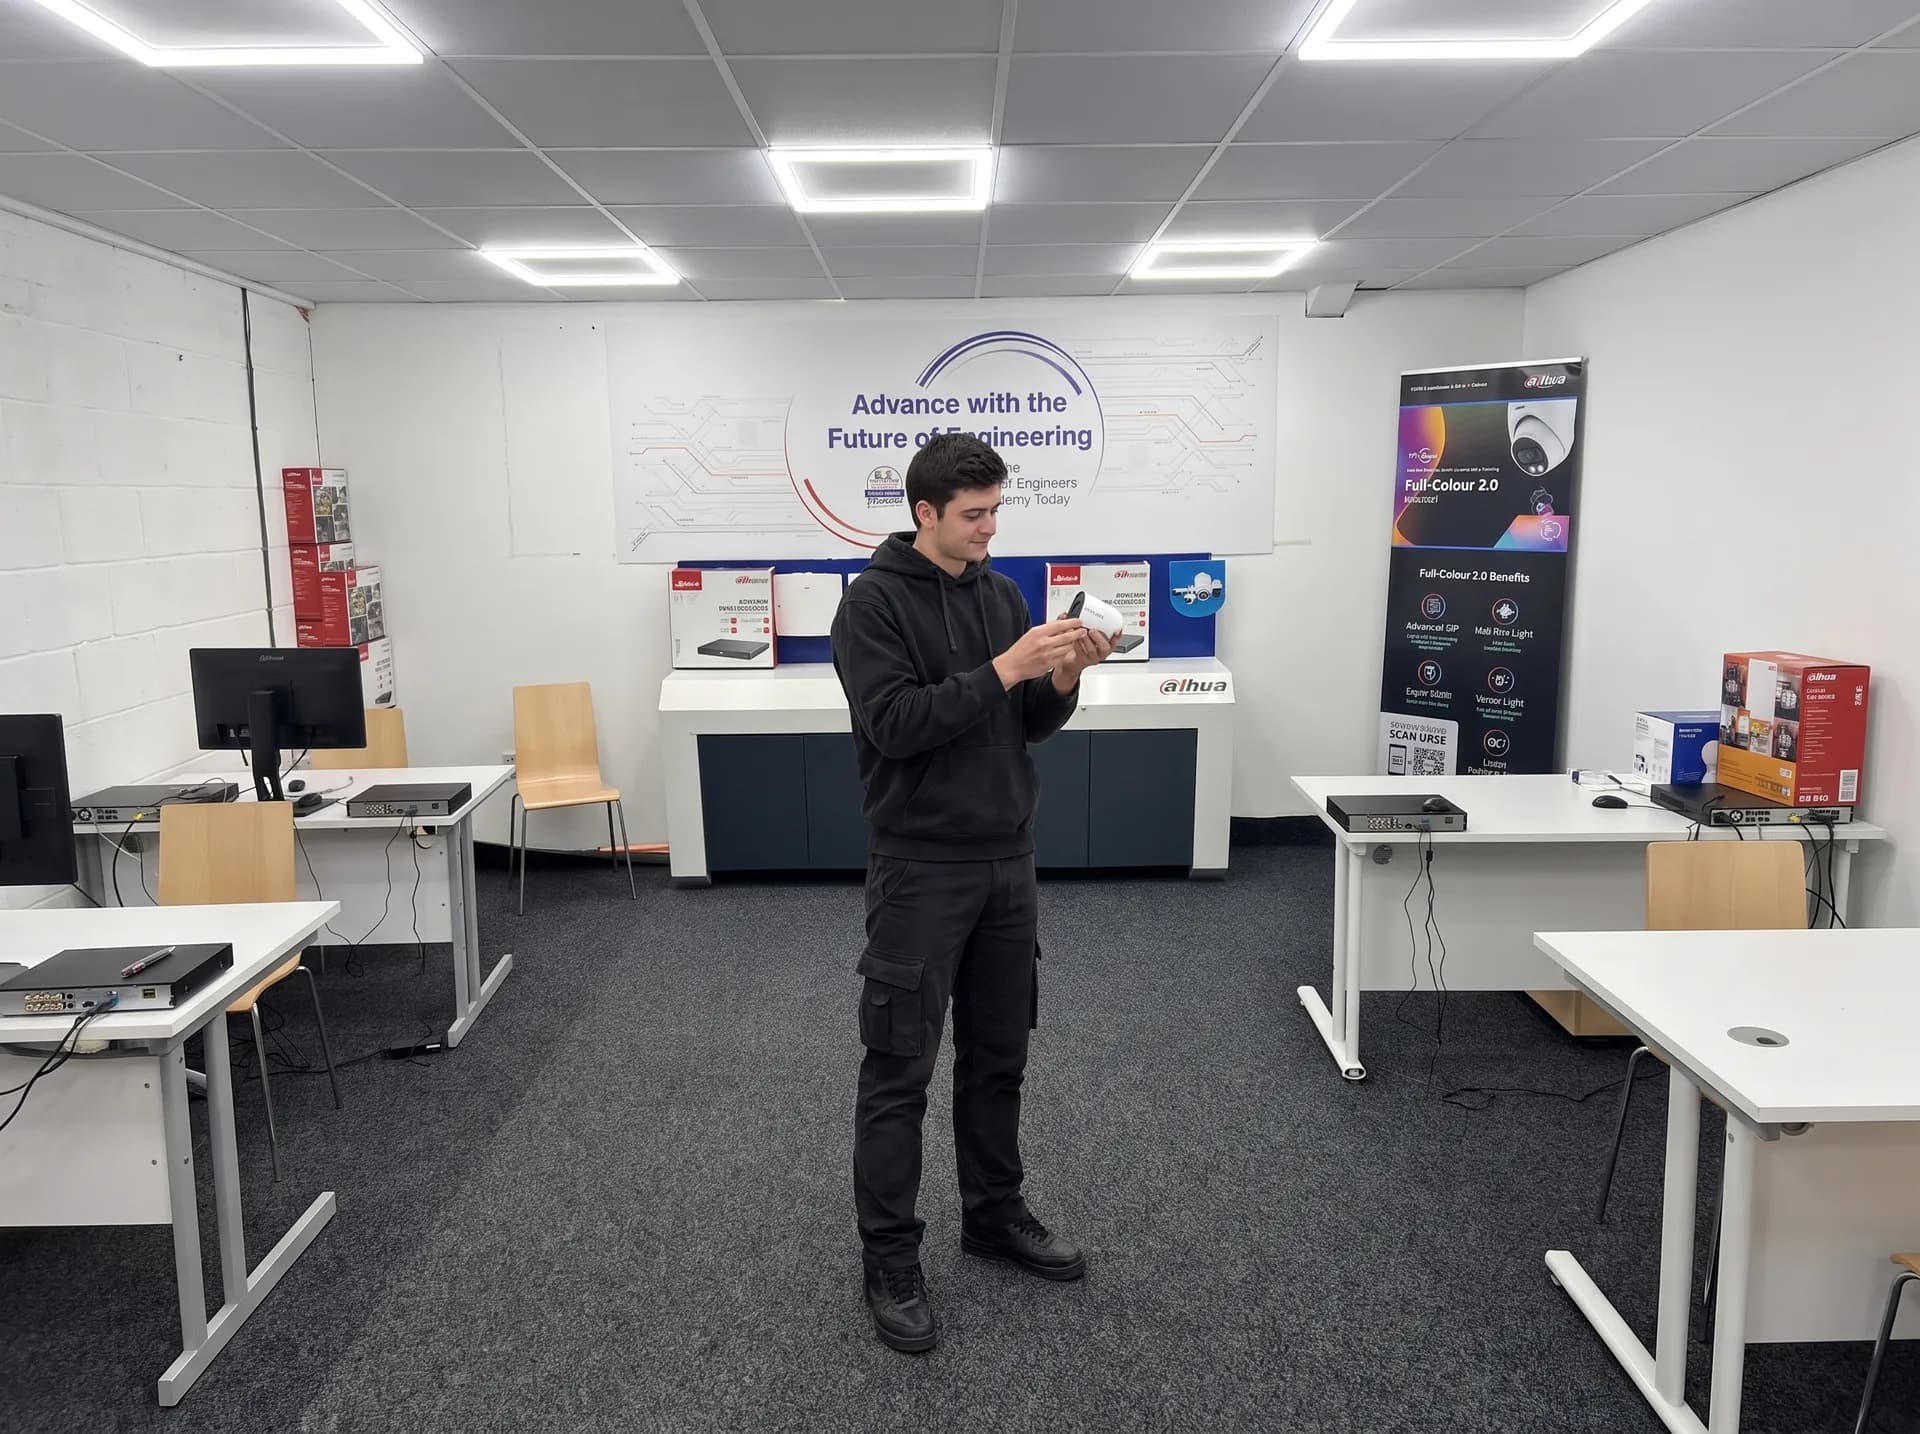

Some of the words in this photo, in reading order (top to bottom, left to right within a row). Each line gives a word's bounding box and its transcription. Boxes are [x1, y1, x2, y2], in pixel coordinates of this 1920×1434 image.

[852, 394, 960, 415] Advance
[967, 392, 1020, 414] with
[1027, 392, 1067, 412] the
[828, 427, 908, 449] Future
[947, 425, 1092, 451] gineering
[1005, 462, 1020, 473] he
[1017, 477, 1078, 492] Engineers
[1405, 478, 1475, 492] Full-Colour
[1478, 478, 1499, 491] 2.0
[1034, 493, 1071, 507] Today
[1419, 568, 1471, 581] Full-Colour
[1472, 570, 1487, 581] 2.0
[1489, 571, 1530, 583] Benefits
[1511, 628, 1534, 640] Light
[1503, 697, 1524, 709] Light
[1389, 729, 1417, 741] SCAN
[1419, 732, 1447, 745] URSE
